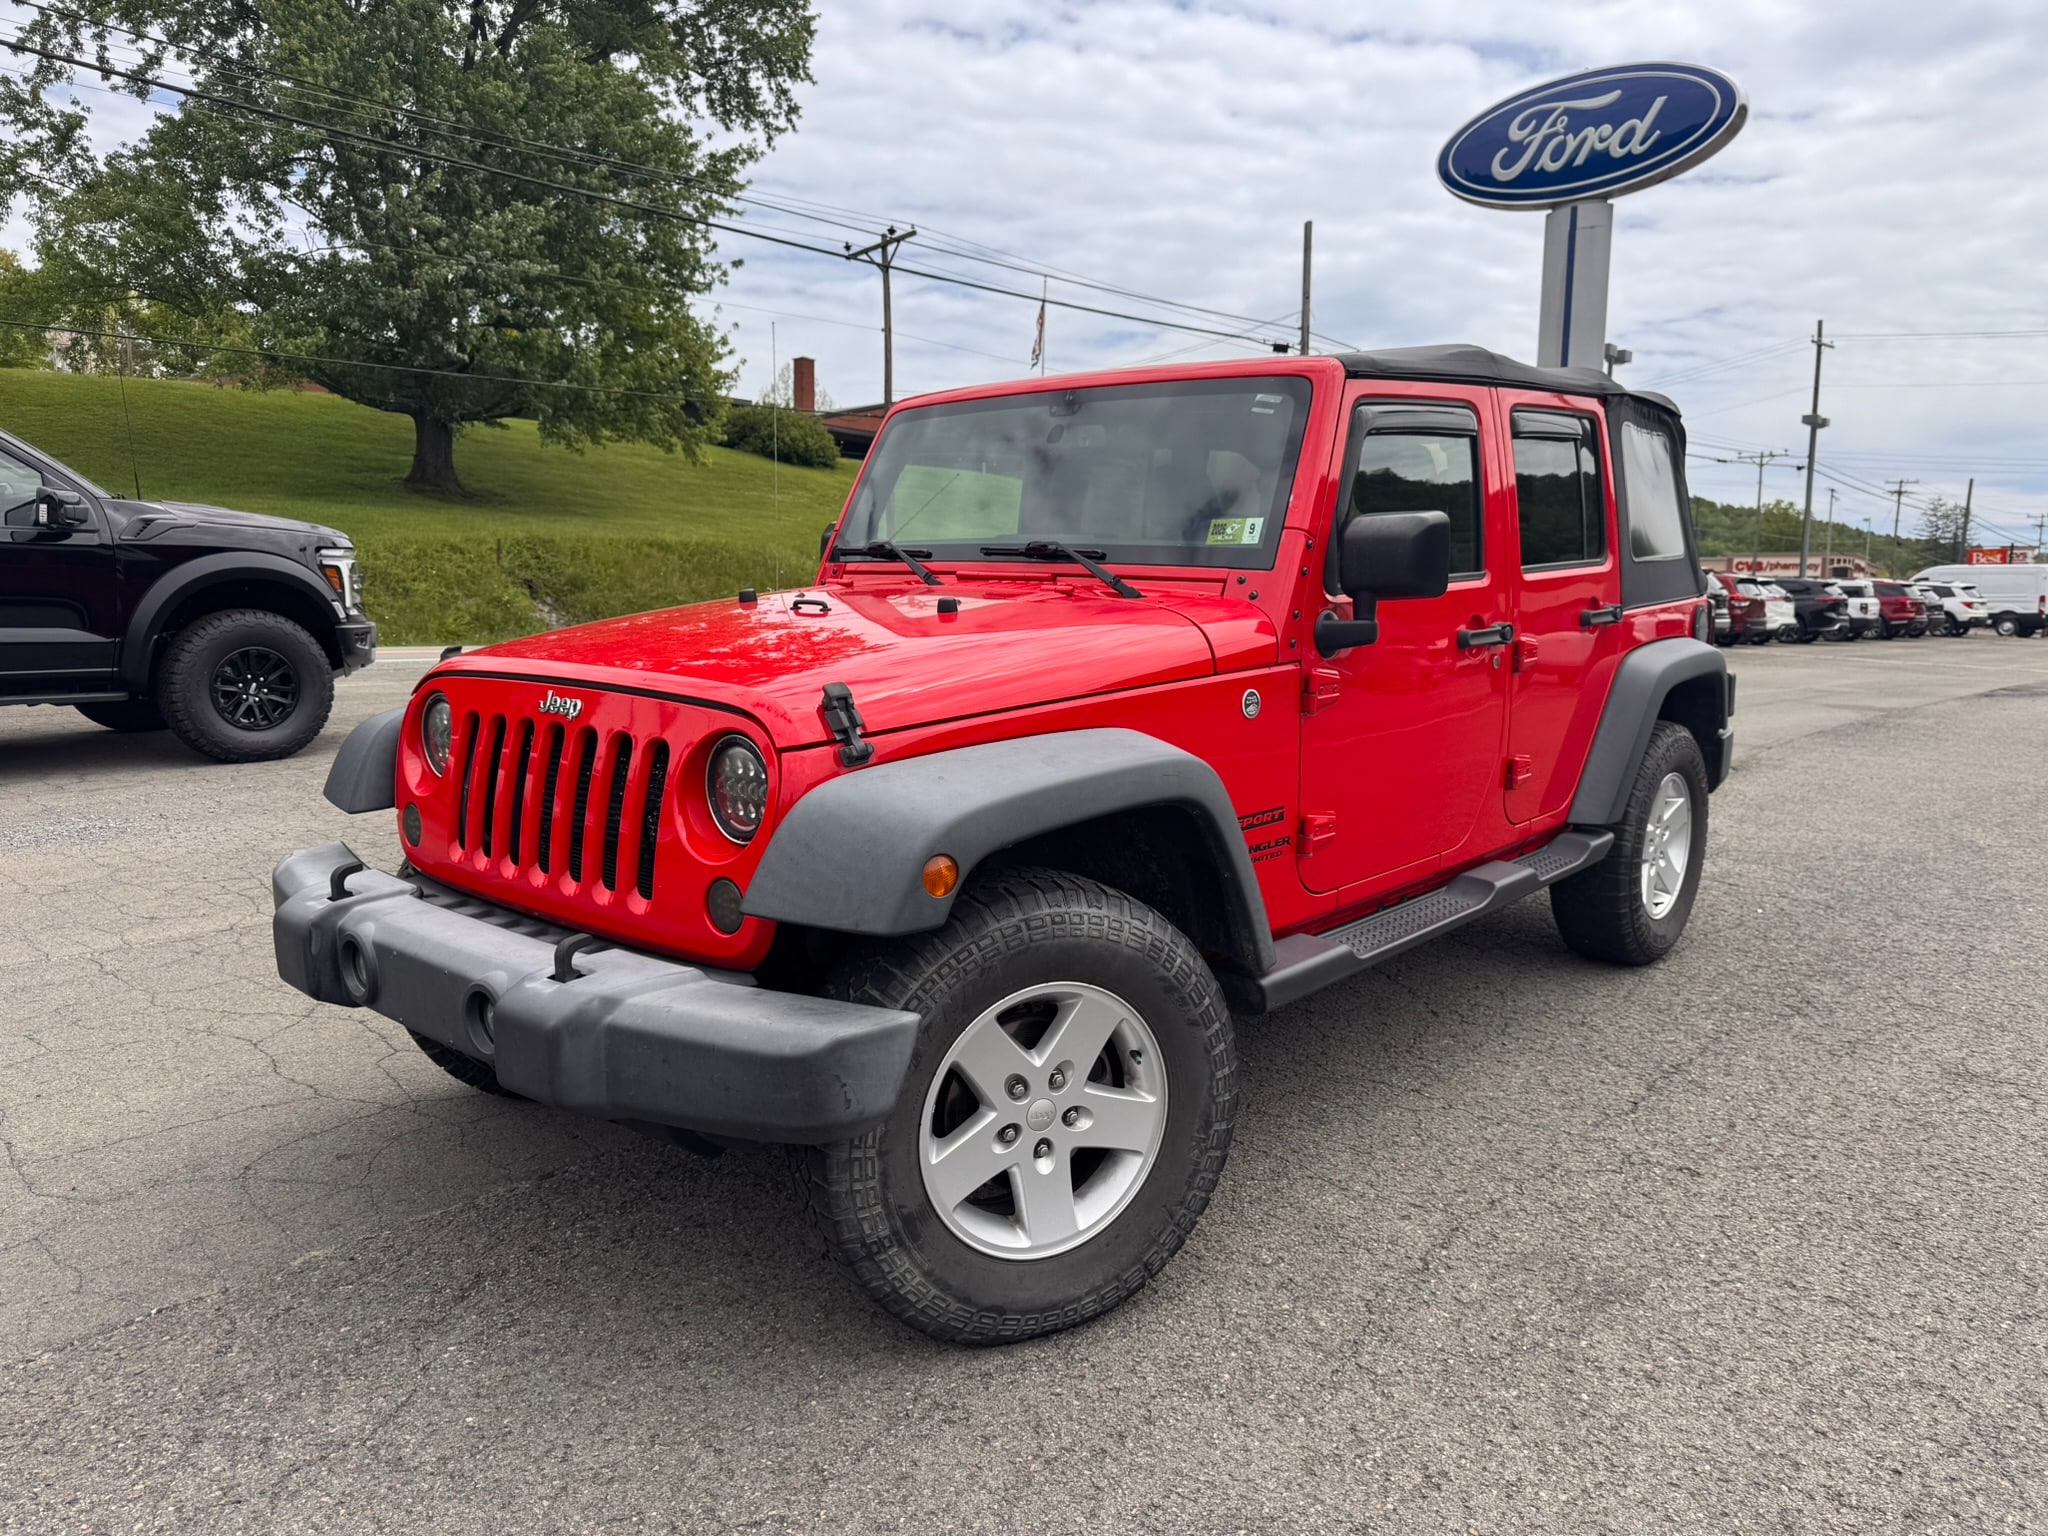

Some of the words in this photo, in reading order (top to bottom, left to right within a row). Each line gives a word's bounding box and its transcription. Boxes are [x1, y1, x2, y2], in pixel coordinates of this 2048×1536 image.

[1491, 89, 1668, 181] Ford
[1248, 522, 1256, 535] 9
[1735, 561, 1820, 573] CVS/pharmcy
[538, 689, 583, 721] Jeep
[1249, 836, 1291, 854] NGLER
